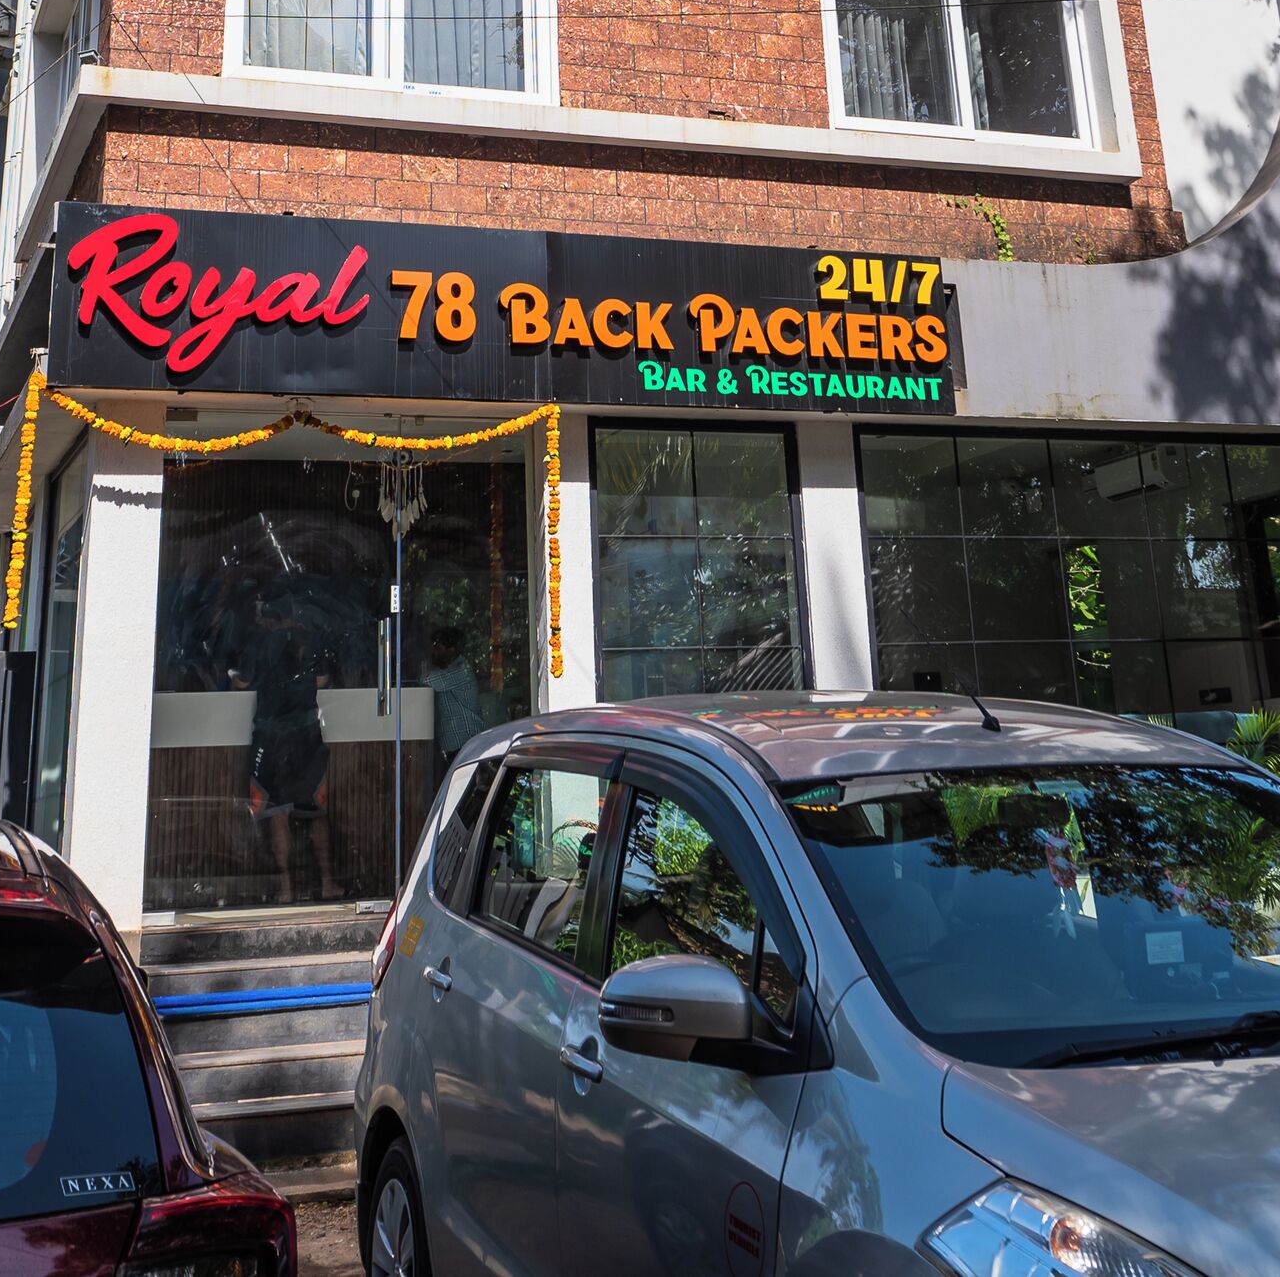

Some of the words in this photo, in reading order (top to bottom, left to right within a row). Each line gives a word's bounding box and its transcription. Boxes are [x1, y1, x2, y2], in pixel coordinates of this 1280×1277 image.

[67, 214, 369, 372] Royal
[391, 270, 477, 342] 78
[500, 282, 675, 350] BACK
[689, 293, 948, 363] PACKERS
[817, 255, 940, 305] 24/7
[638, 361, 707, 393] BAR
[717, 367, 738, 395] &
[746, 364, 942, 400] RESTAURANT
[67, 1174, 131, 1192] NEXA
